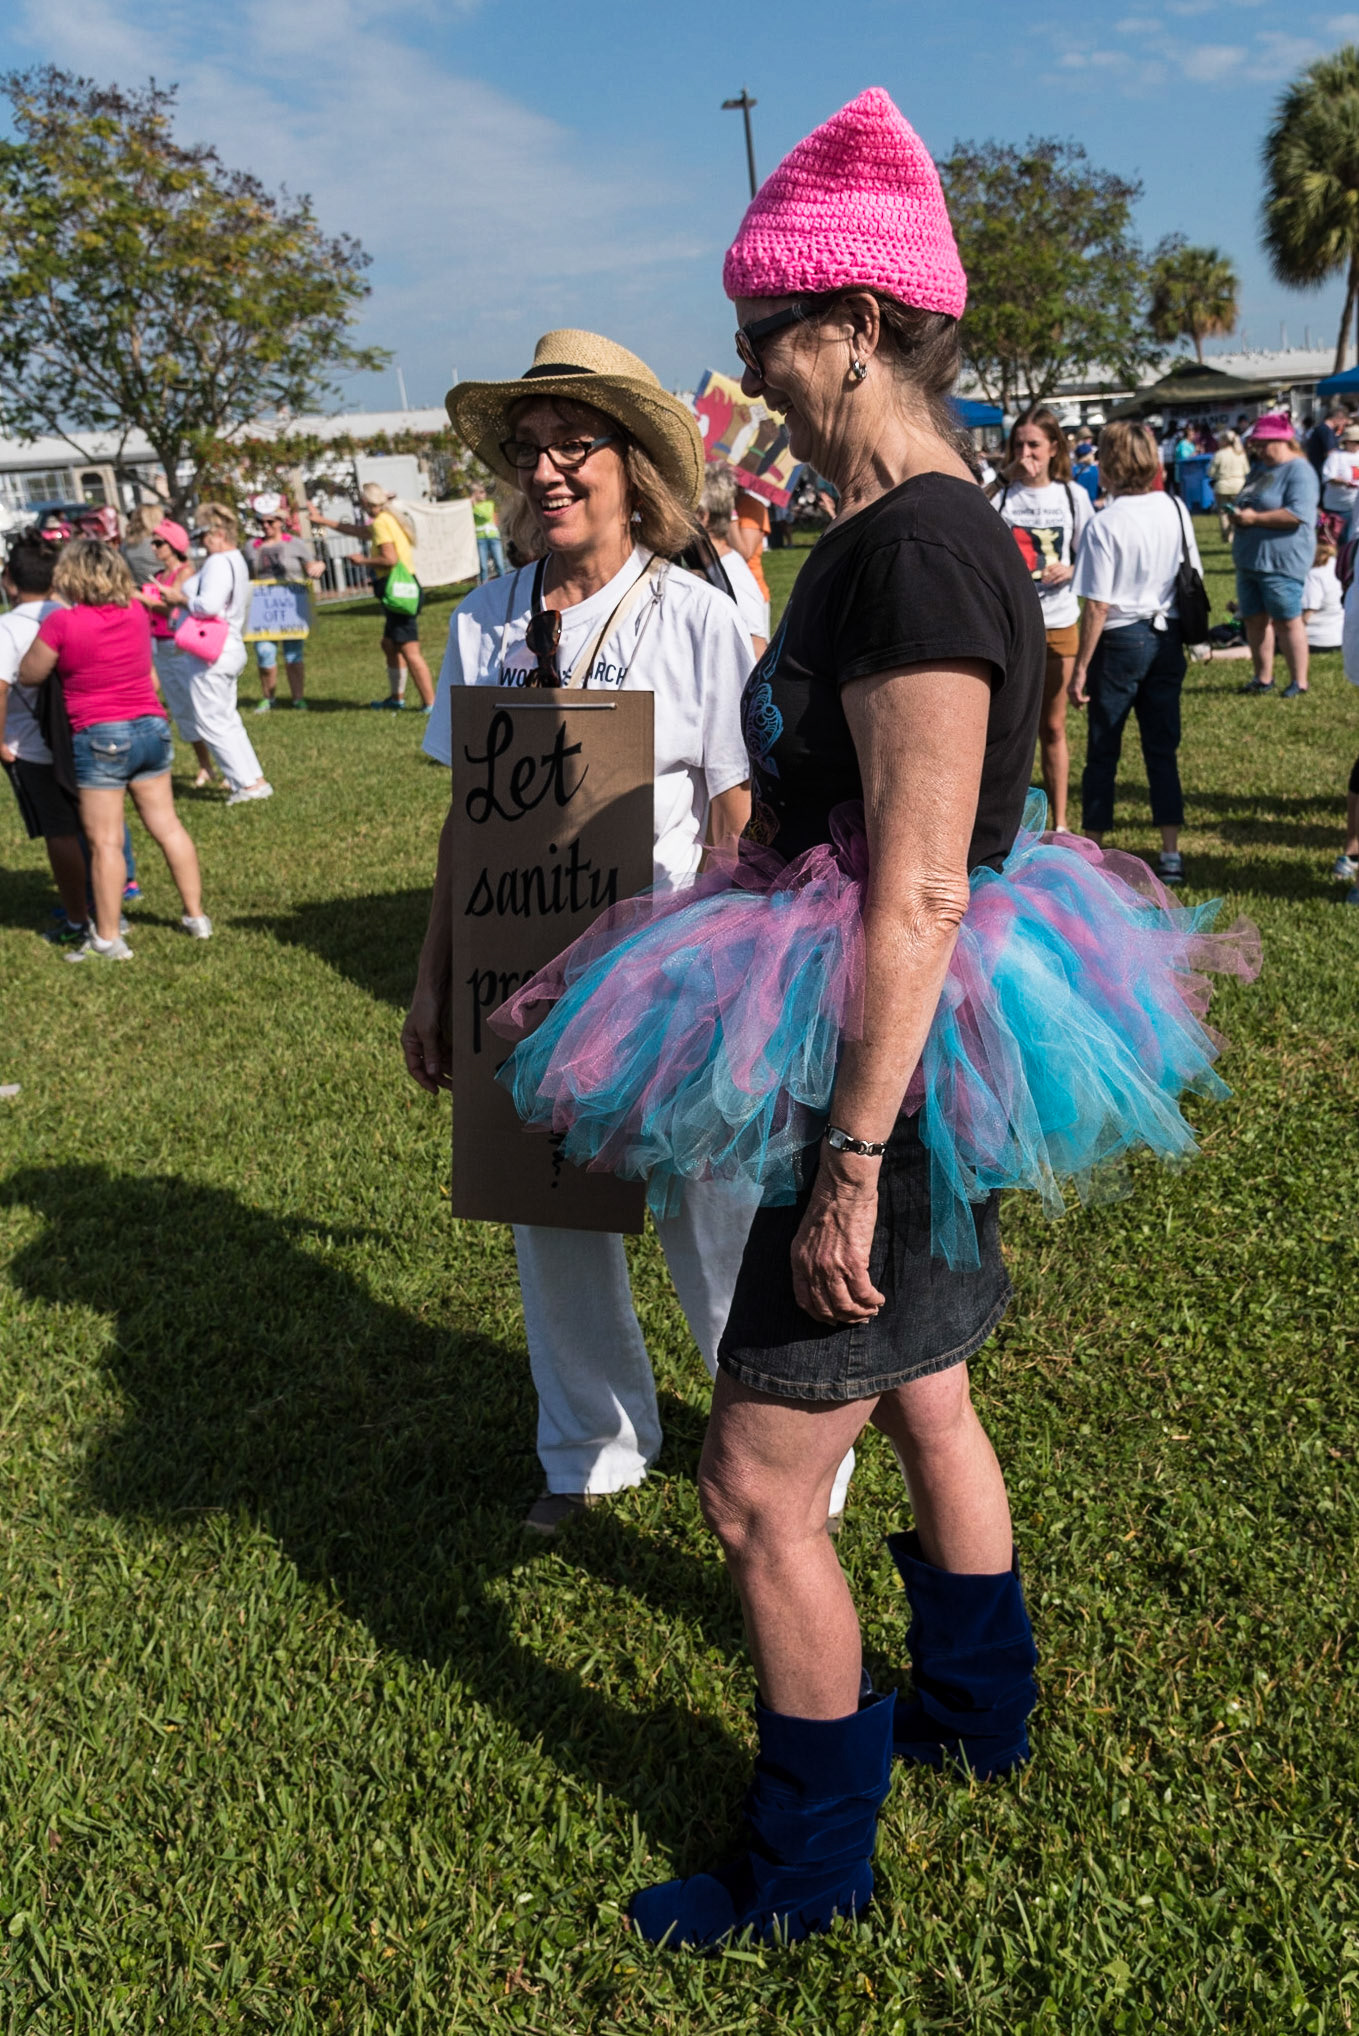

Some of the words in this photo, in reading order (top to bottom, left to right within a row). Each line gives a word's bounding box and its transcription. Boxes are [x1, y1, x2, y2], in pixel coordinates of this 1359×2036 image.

[263, 609, 286, 623] OFF
[464, 711, 589, 824] Let
[464, 837, 618, 922] sanity
